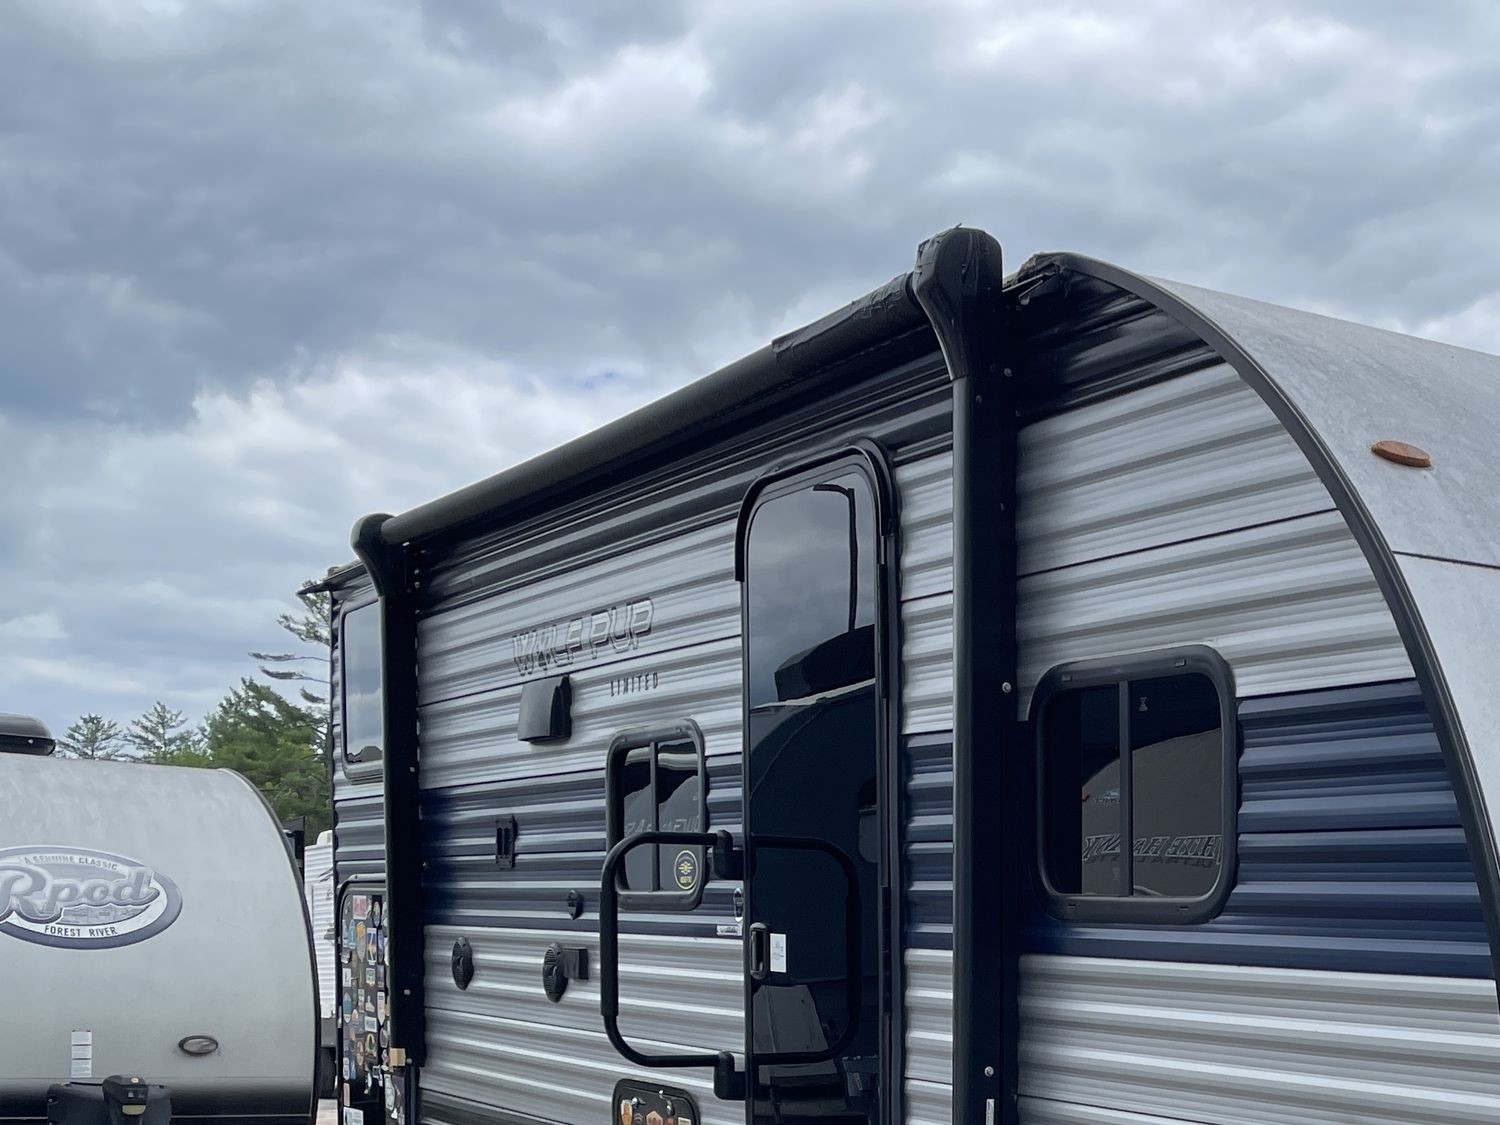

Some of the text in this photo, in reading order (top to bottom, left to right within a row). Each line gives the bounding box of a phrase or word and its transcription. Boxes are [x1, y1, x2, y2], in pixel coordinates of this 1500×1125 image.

[589, 597, 654, 660] PUP
[610, 671, 660, 698] LIMITED
[78, 856, 119, 870] CLASSIC
[44, 924, 119, 938] FOREST RIVER
